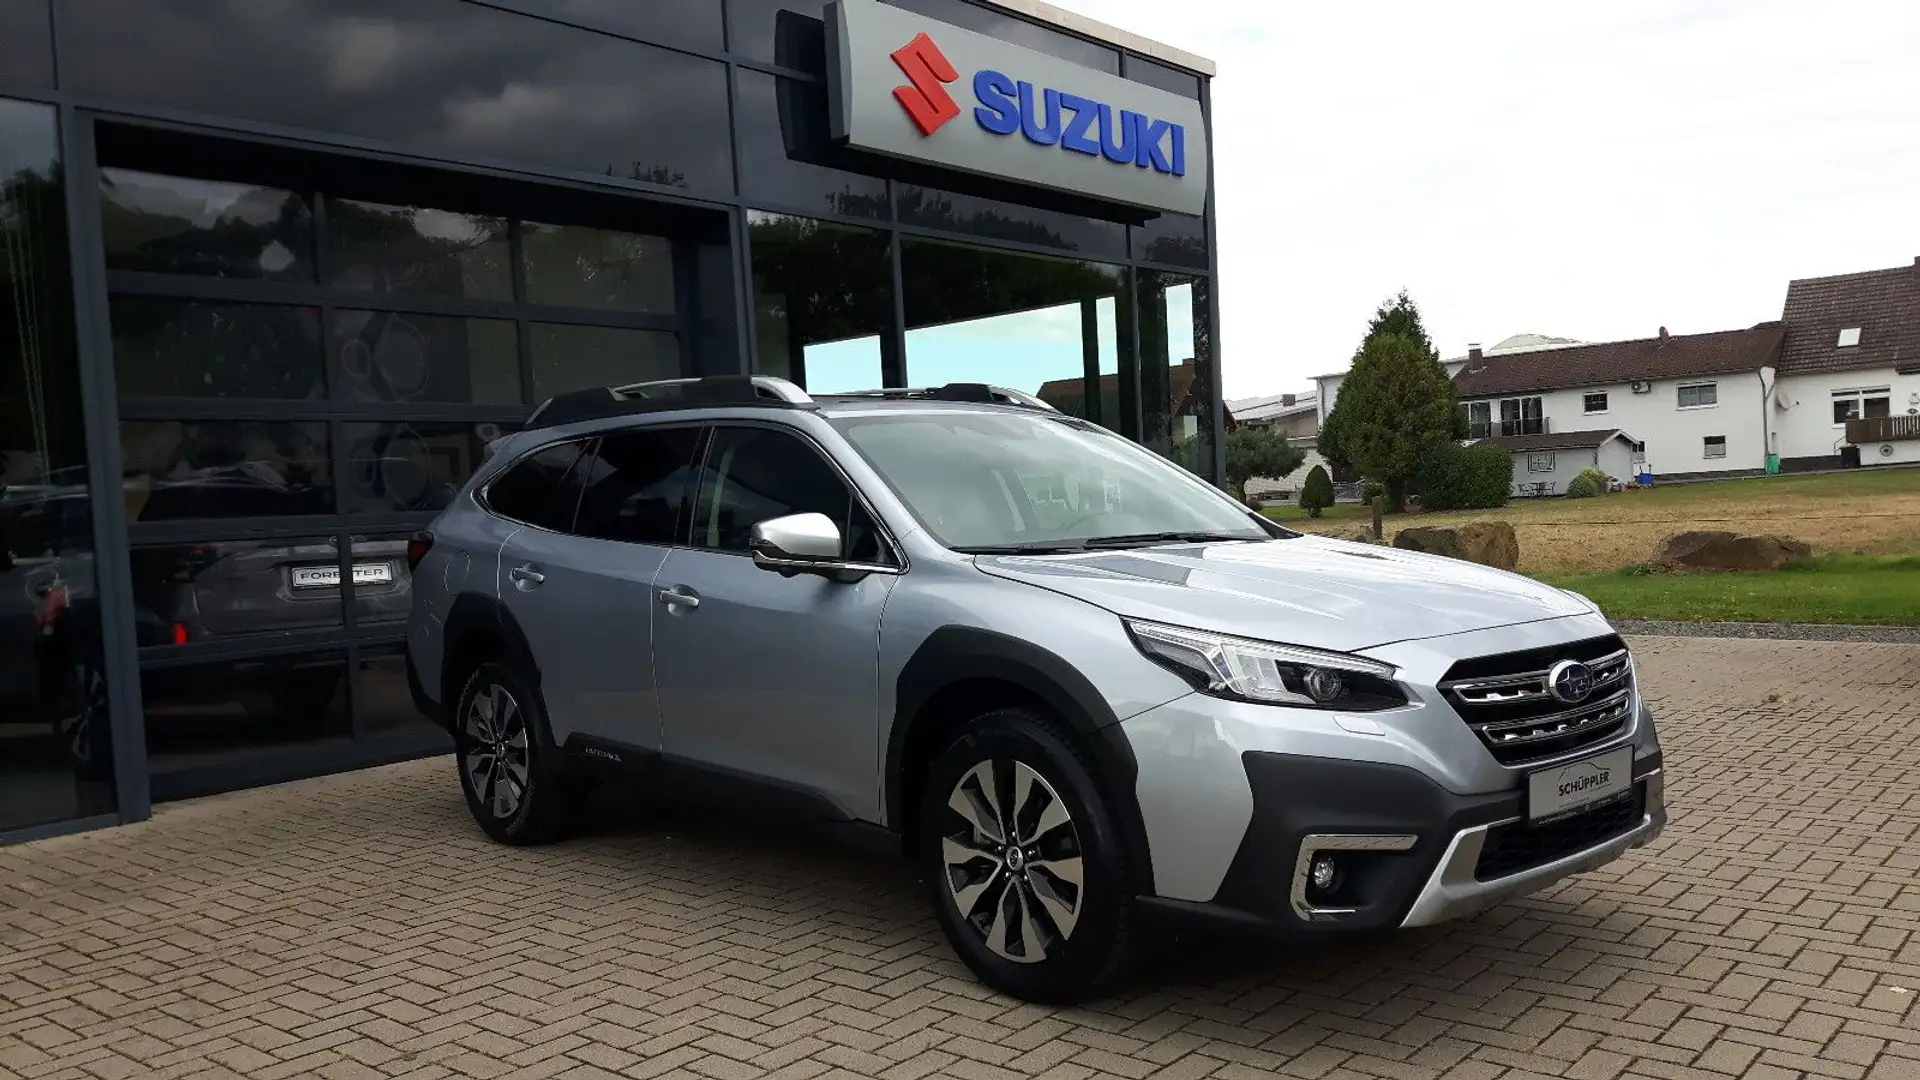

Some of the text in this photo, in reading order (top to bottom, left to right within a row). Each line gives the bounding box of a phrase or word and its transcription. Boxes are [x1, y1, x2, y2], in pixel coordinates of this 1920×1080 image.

[974, 69, 1185, 177] SUZUKI
[301, 568, 384, 580] FORETER
[1558, 771, 1610, 797] SCHÜPPLER
